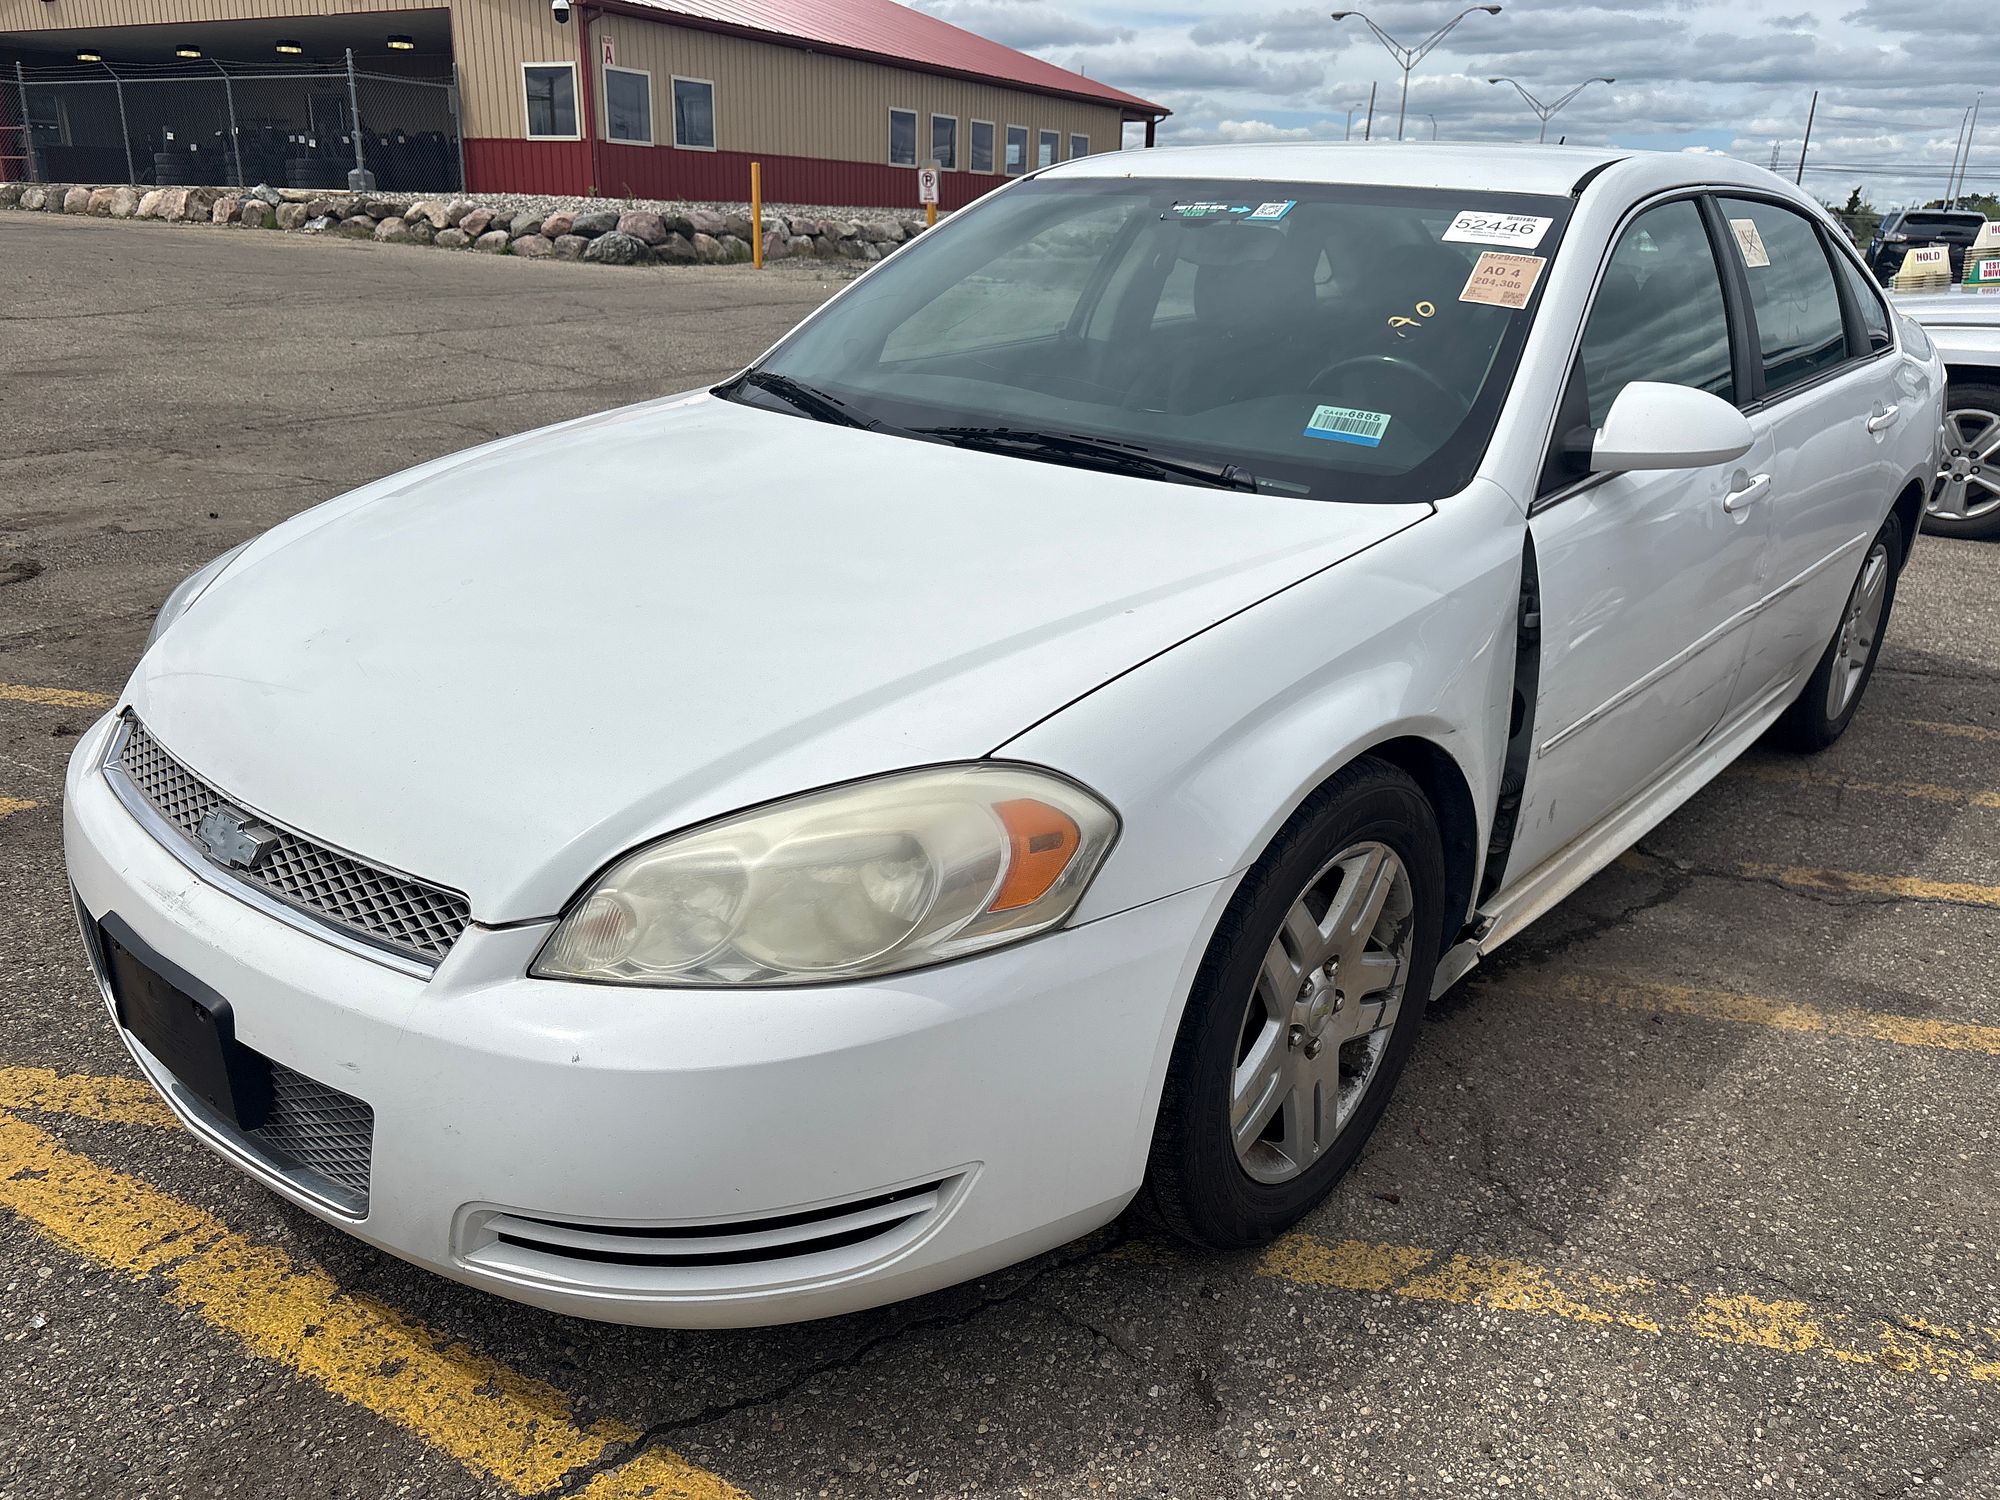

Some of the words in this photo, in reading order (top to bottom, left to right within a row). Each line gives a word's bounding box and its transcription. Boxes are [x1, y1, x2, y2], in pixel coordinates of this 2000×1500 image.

[605, 46, 613, 64] A
[1455, 218, 1536, 235] 52446
[1916, 251, 1940, 261] HOLD
[1511, 269, 1521, 278] 4
[1984, 270, 2000, 278] DRIV
